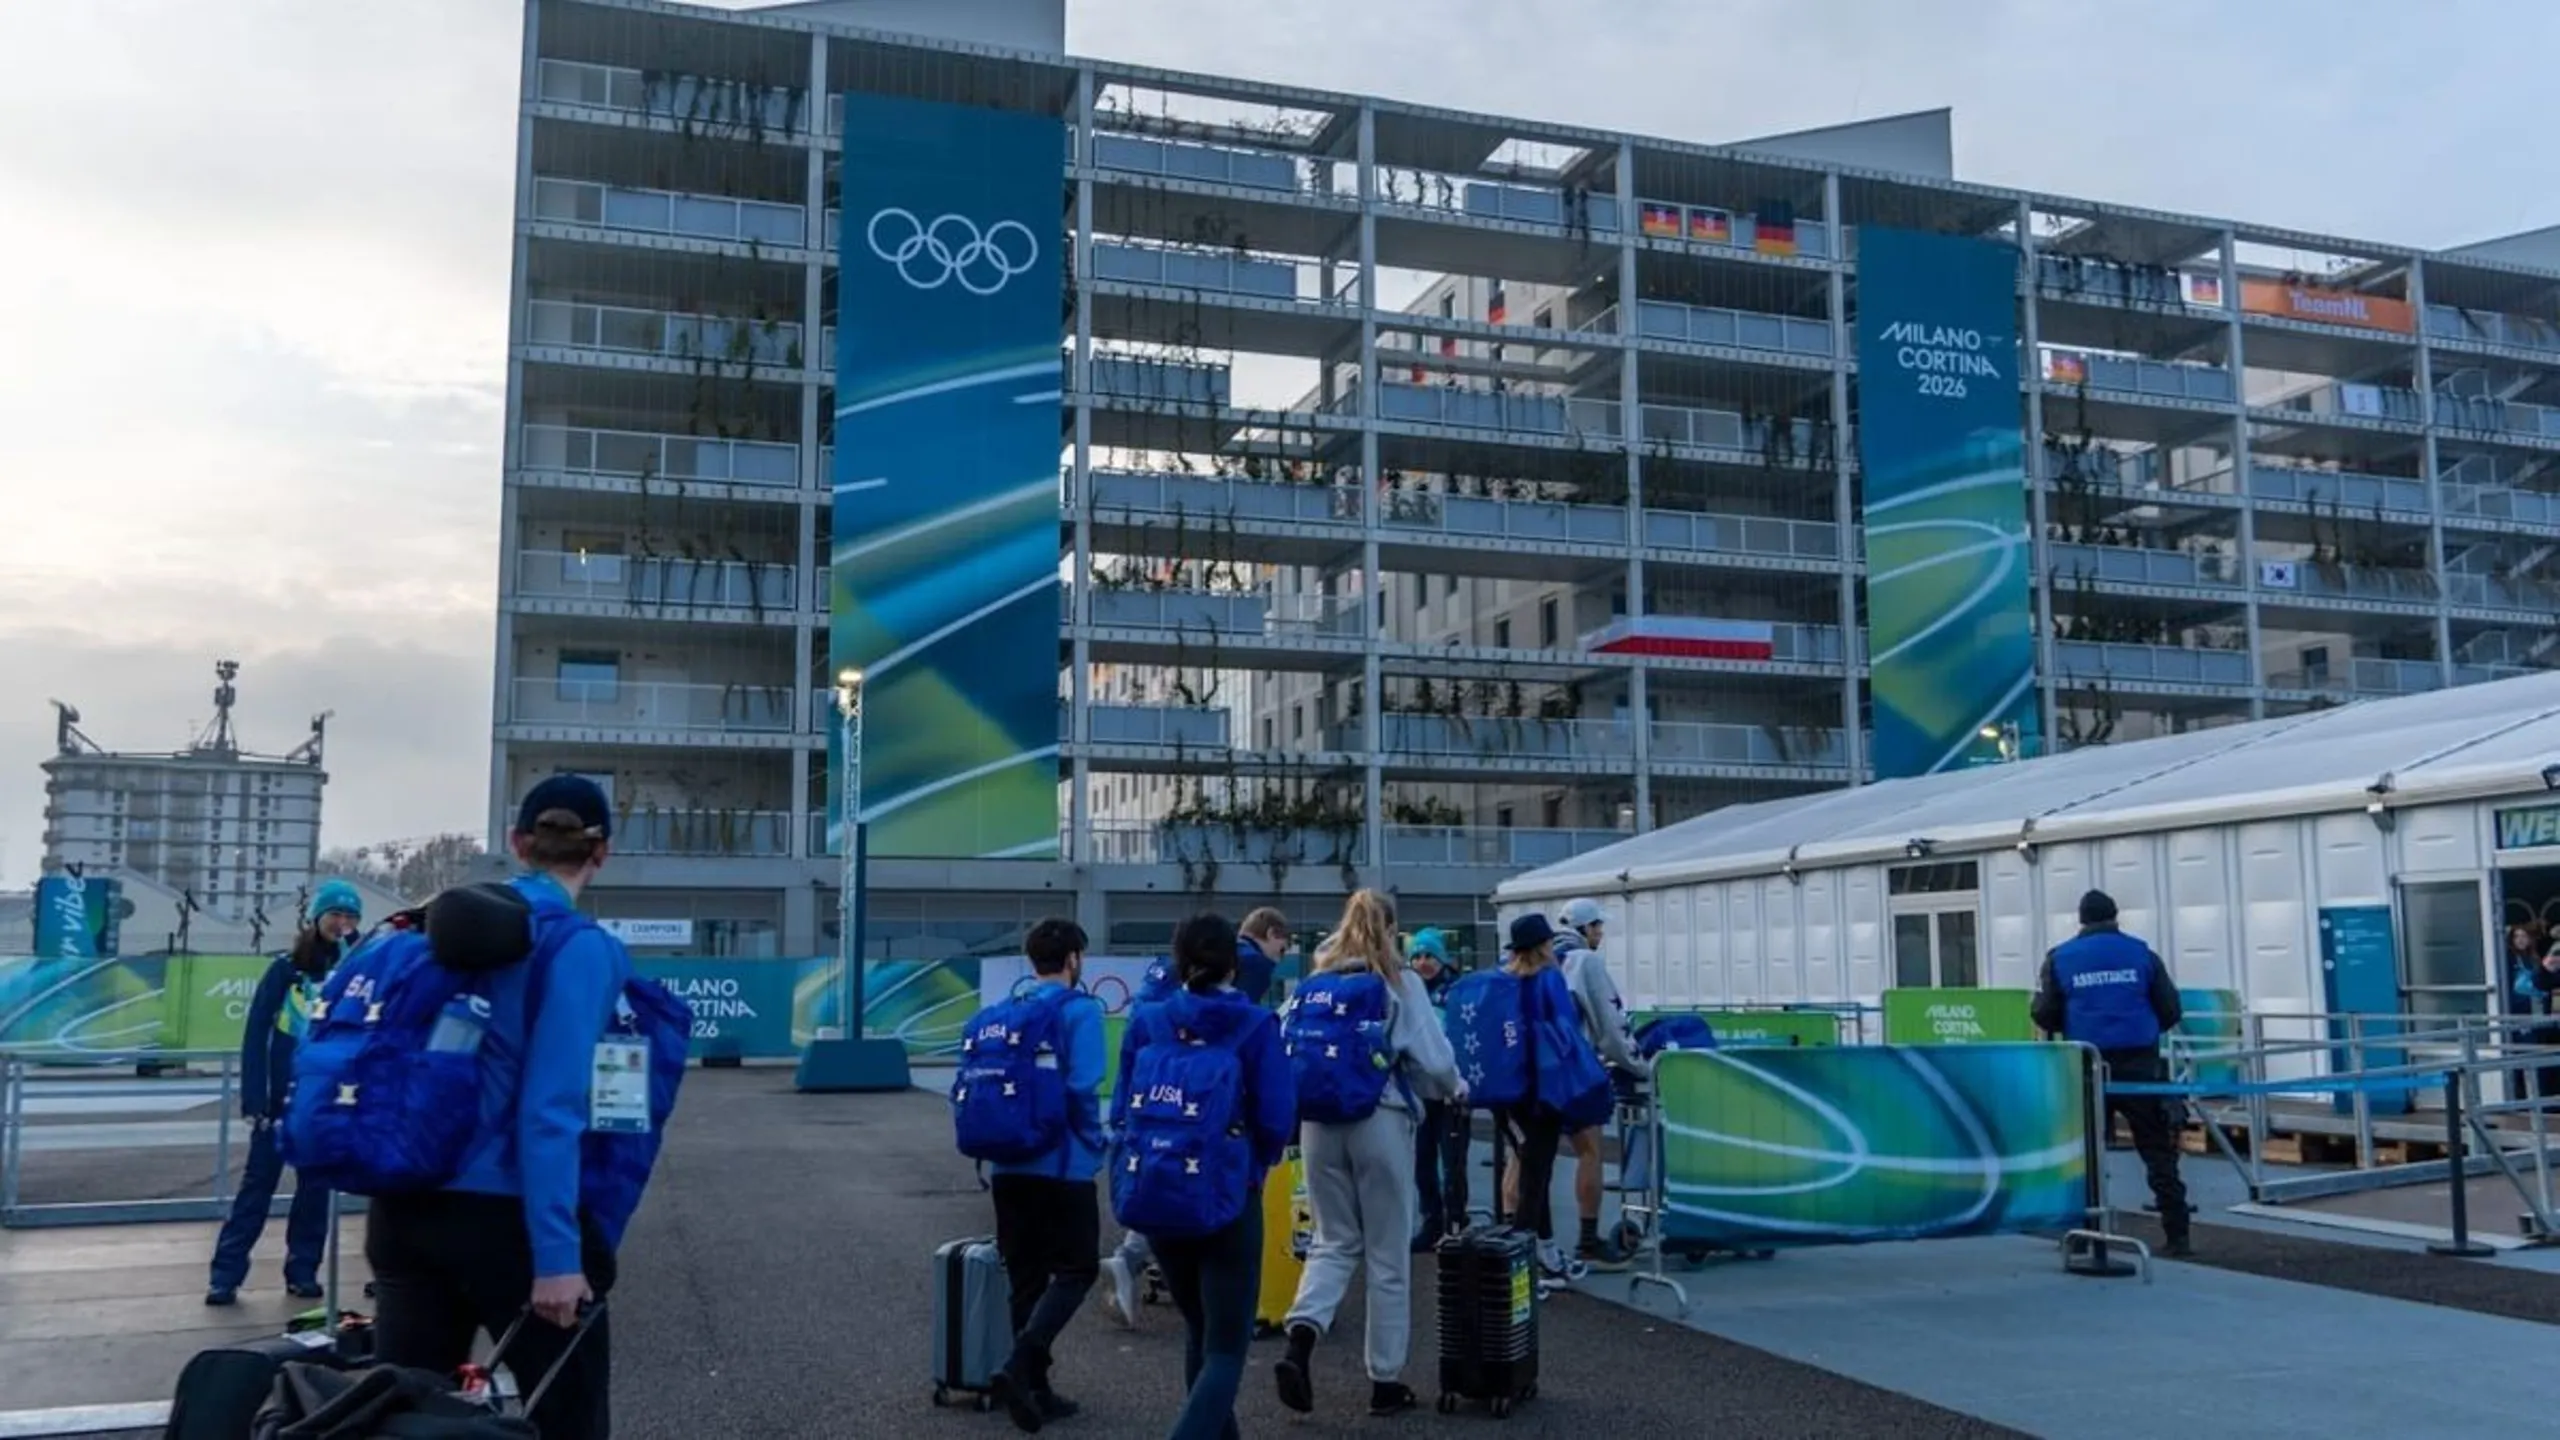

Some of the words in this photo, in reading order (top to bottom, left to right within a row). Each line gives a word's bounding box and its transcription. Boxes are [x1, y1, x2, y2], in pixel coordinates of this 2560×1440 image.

[2289, 289, 2369, 321] TeamNL
[1879, 321, 1981, 351] MILANO
[1897, 345, 2001, 379] CORTINA
[1918, 373, 1968, 399] 2026
[2501, 811, 2560, 848] WE
[344, 973, 376, 1004] SA
[660, 977, 739, 997] ILANO
[2073, 969, 2138, 988] ASSISTANCE
[687, 999, 758, 1018] RTINA
[1305, 990, 1332, 1006] USA
[1925, 1003, 1976, 1019] MILANO
[691, 1020, 719, 1038] 26
[979, 1024, 1006, 1041] USA
[1504, 1021, 1518, 1048] USA
[1932, 1020, 1987, 1037] CORTINA
[1149, 1084, 1183, 1107] USA
